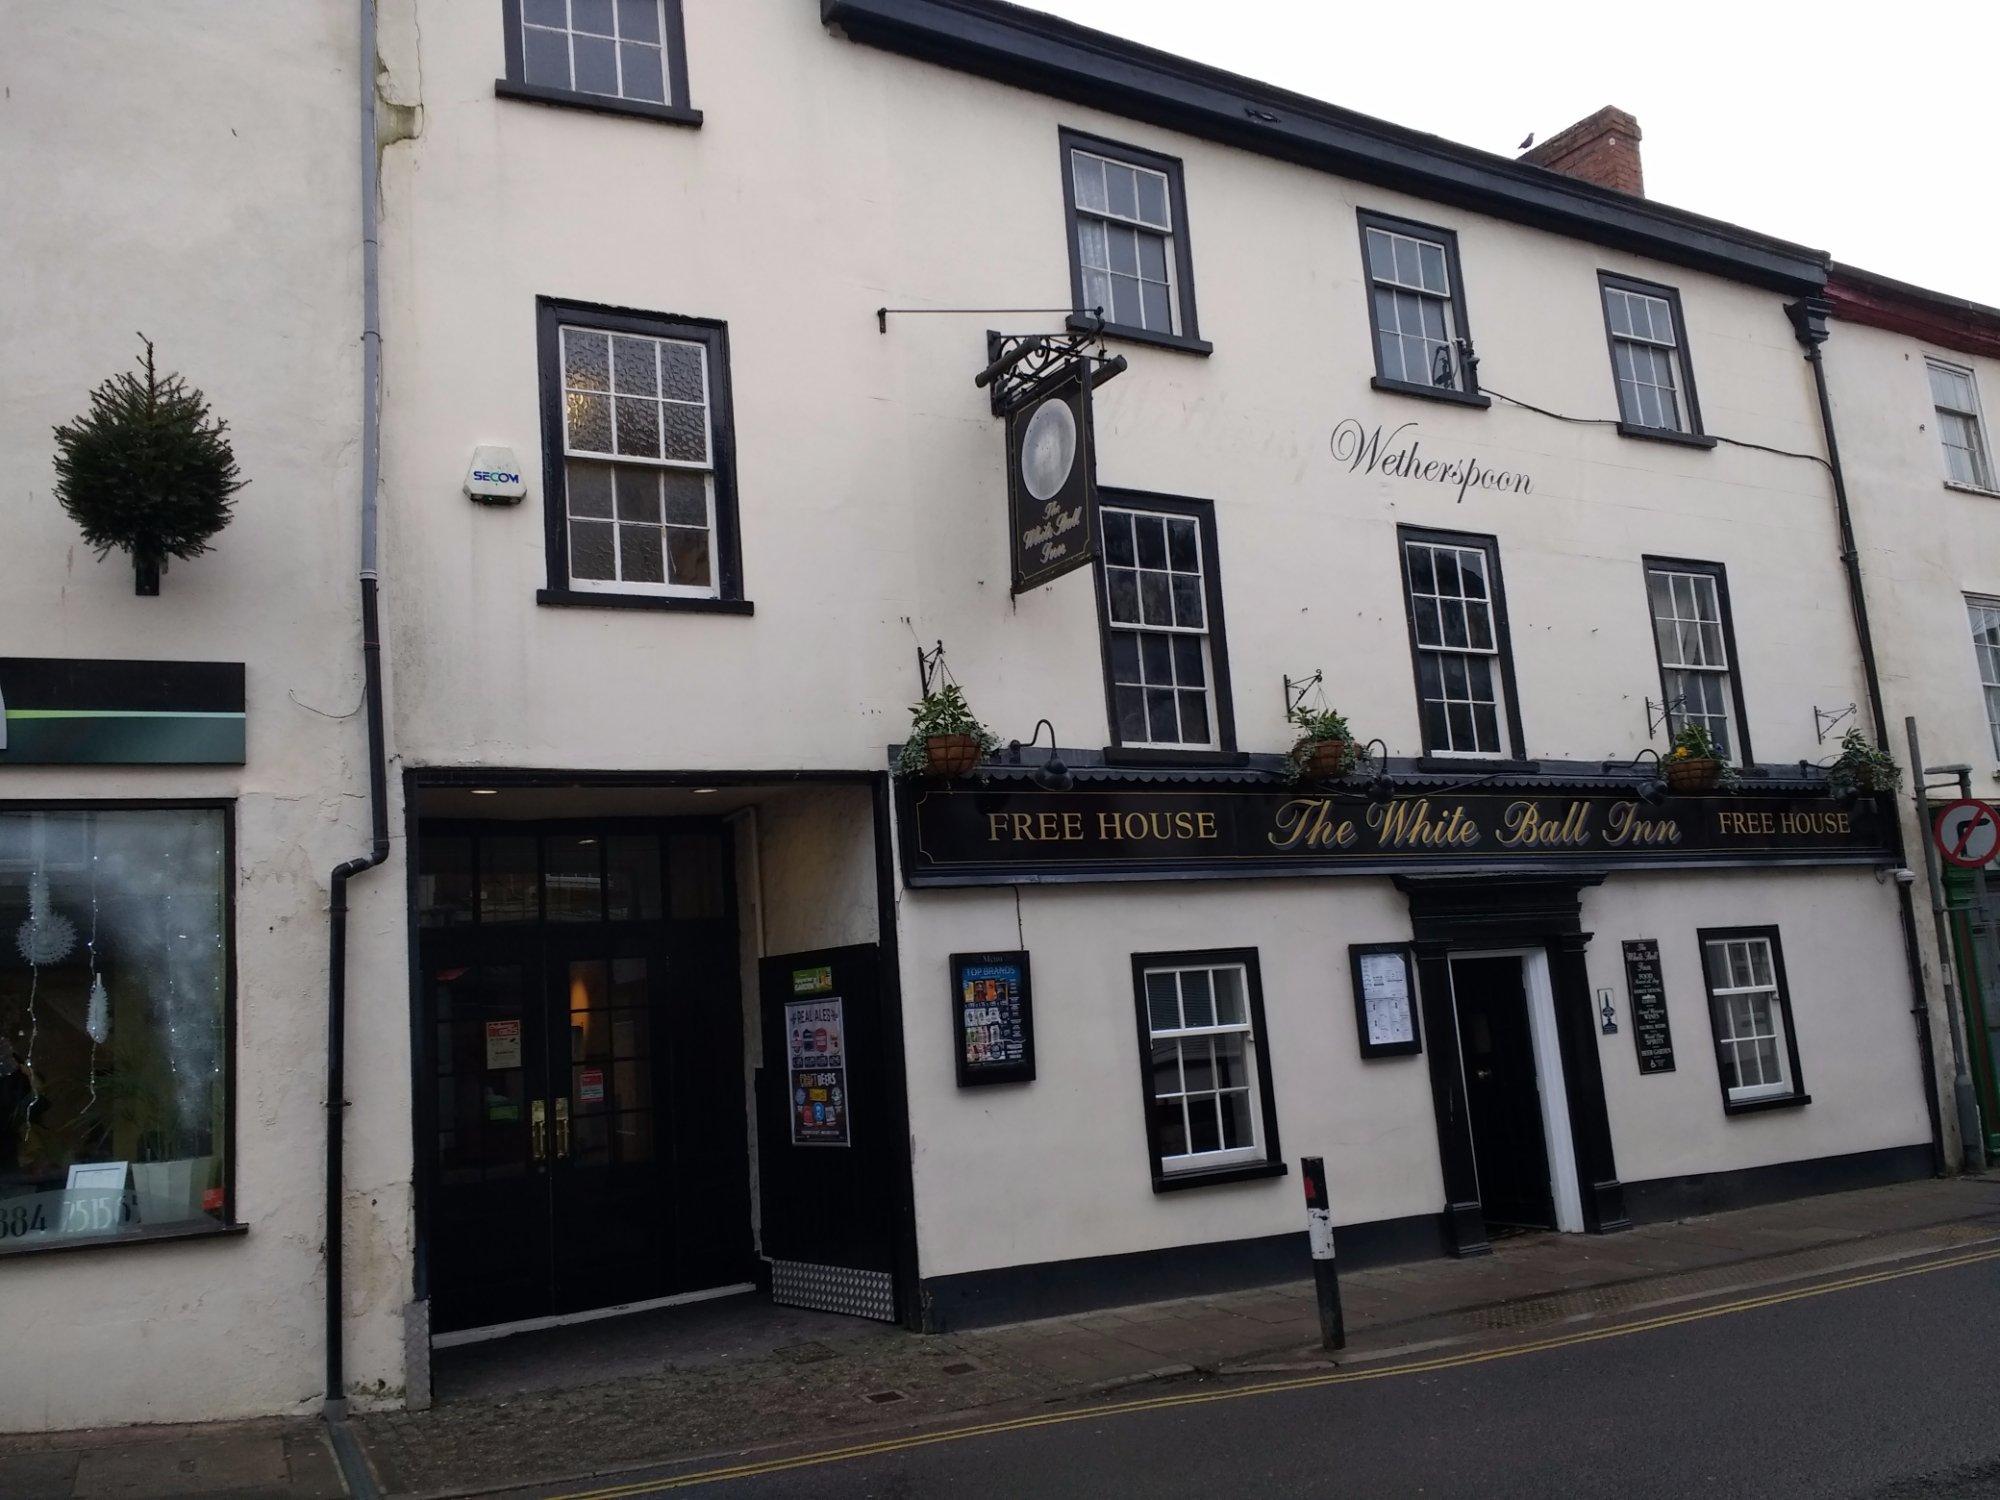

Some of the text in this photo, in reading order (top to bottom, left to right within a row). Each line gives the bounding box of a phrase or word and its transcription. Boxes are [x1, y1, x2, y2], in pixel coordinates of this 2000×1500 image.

[1331, 418, 1535, 504] Wetherspoon
[473, 470, 520, 484] SECOM
[1041, 500, 1061, 521] The
[1023, 506, 1083, 551] White Ball
[1040, 541, 1067, 564] Inn
[987, 811, 1218, 842] FREE HOUSE
[1267, 798, 1683, 850] The White Ball Inn
[1718, 812, 1851, 835] FREE HOUSE
